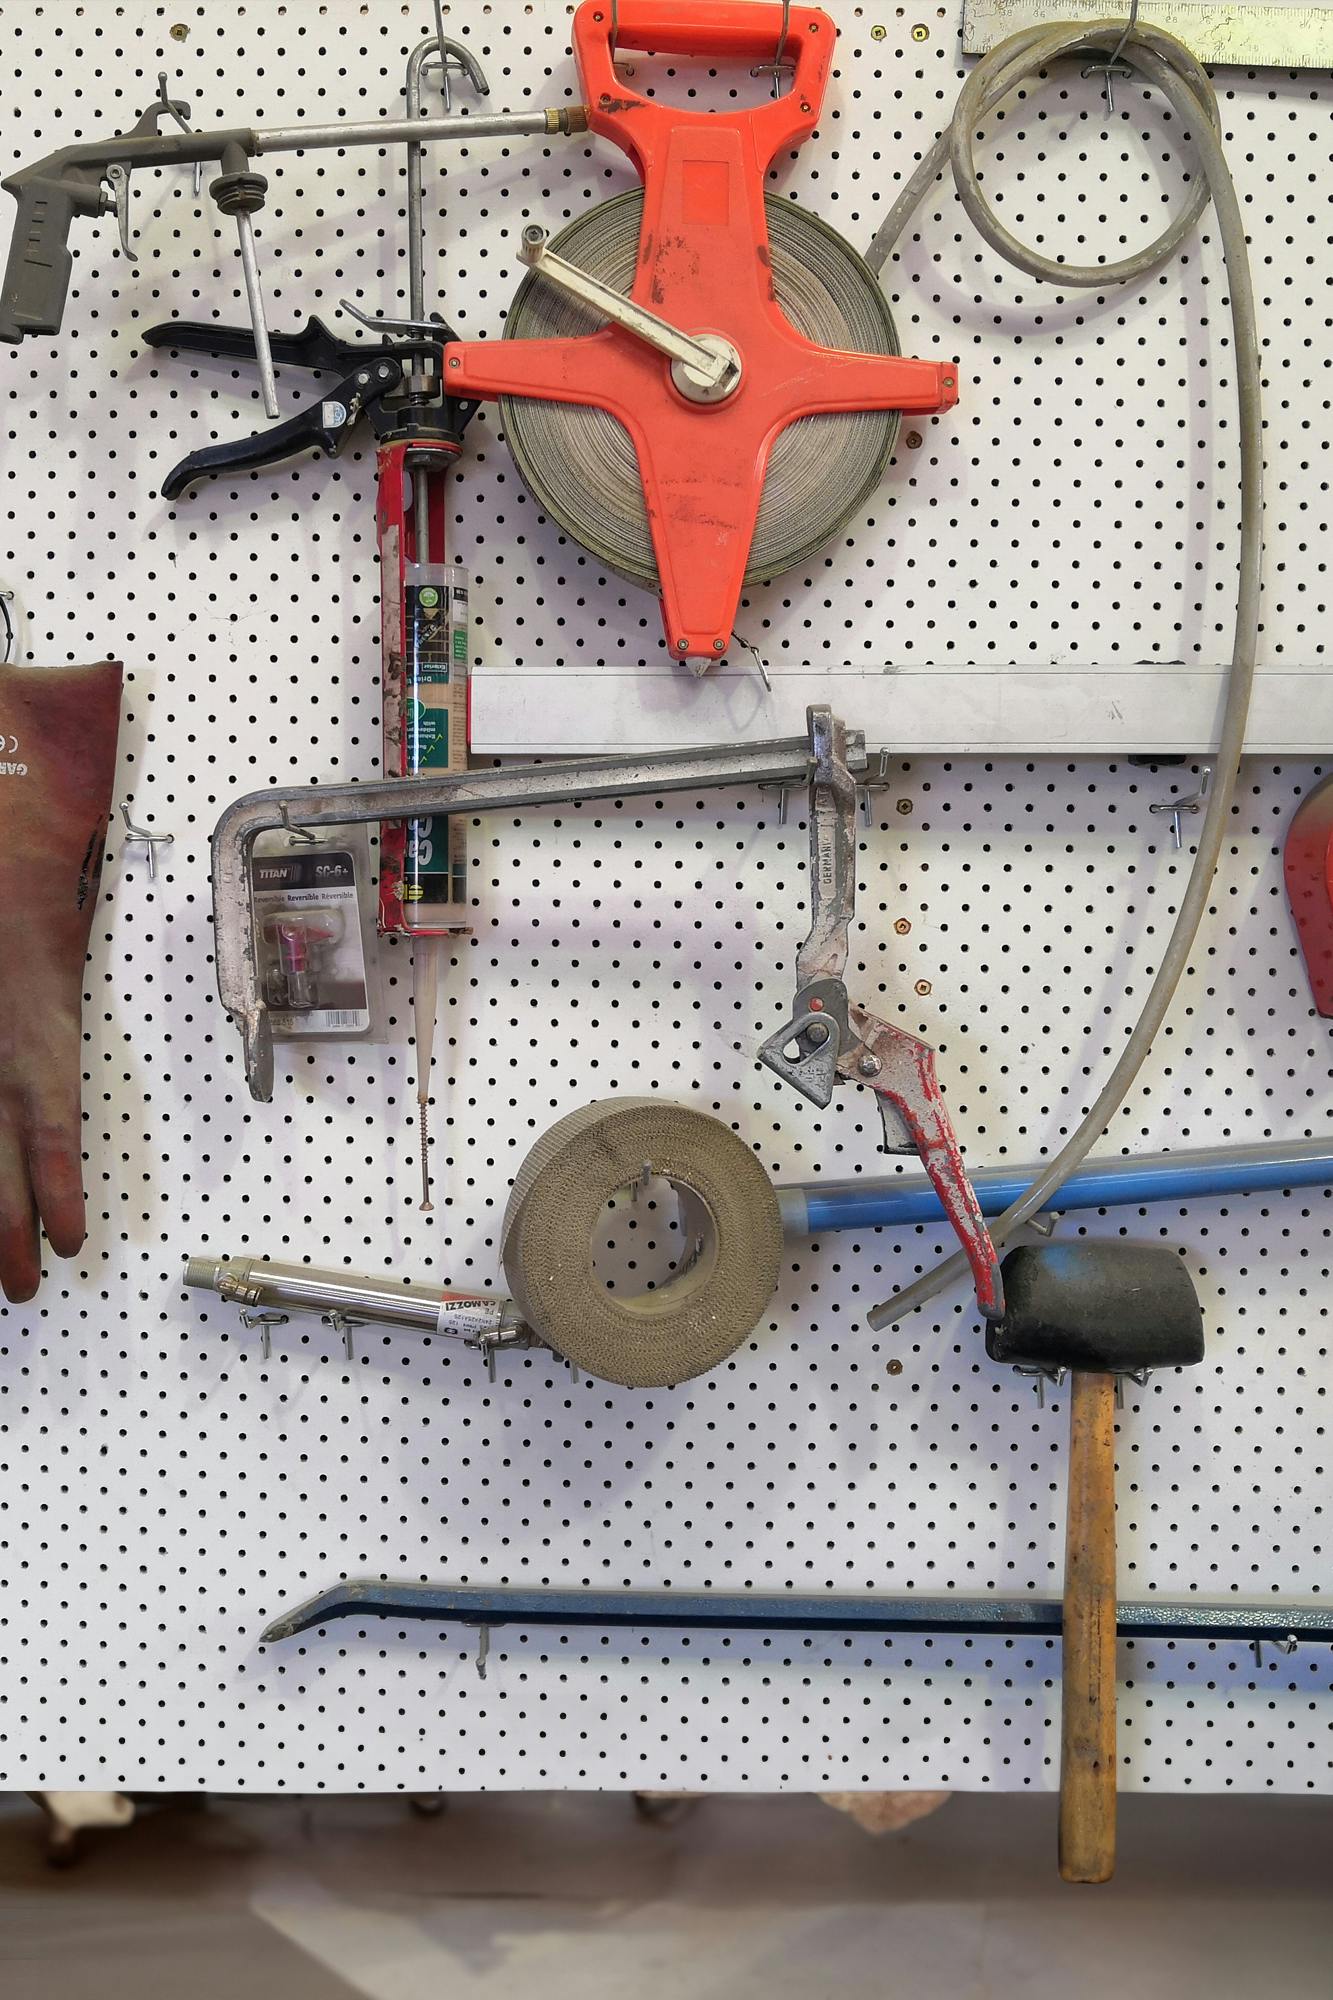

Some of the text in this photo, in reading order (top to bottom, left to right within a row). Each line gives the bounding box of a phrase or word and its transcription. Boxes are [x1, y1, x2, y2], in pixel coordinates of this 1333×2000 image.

[259, 868, 288, 879] TITAN
[315, 864, 349, 878] SC-6+
[287, 893, 319, 902] Reversible
[445, 1300, 496, 1311] CAMOZZI
